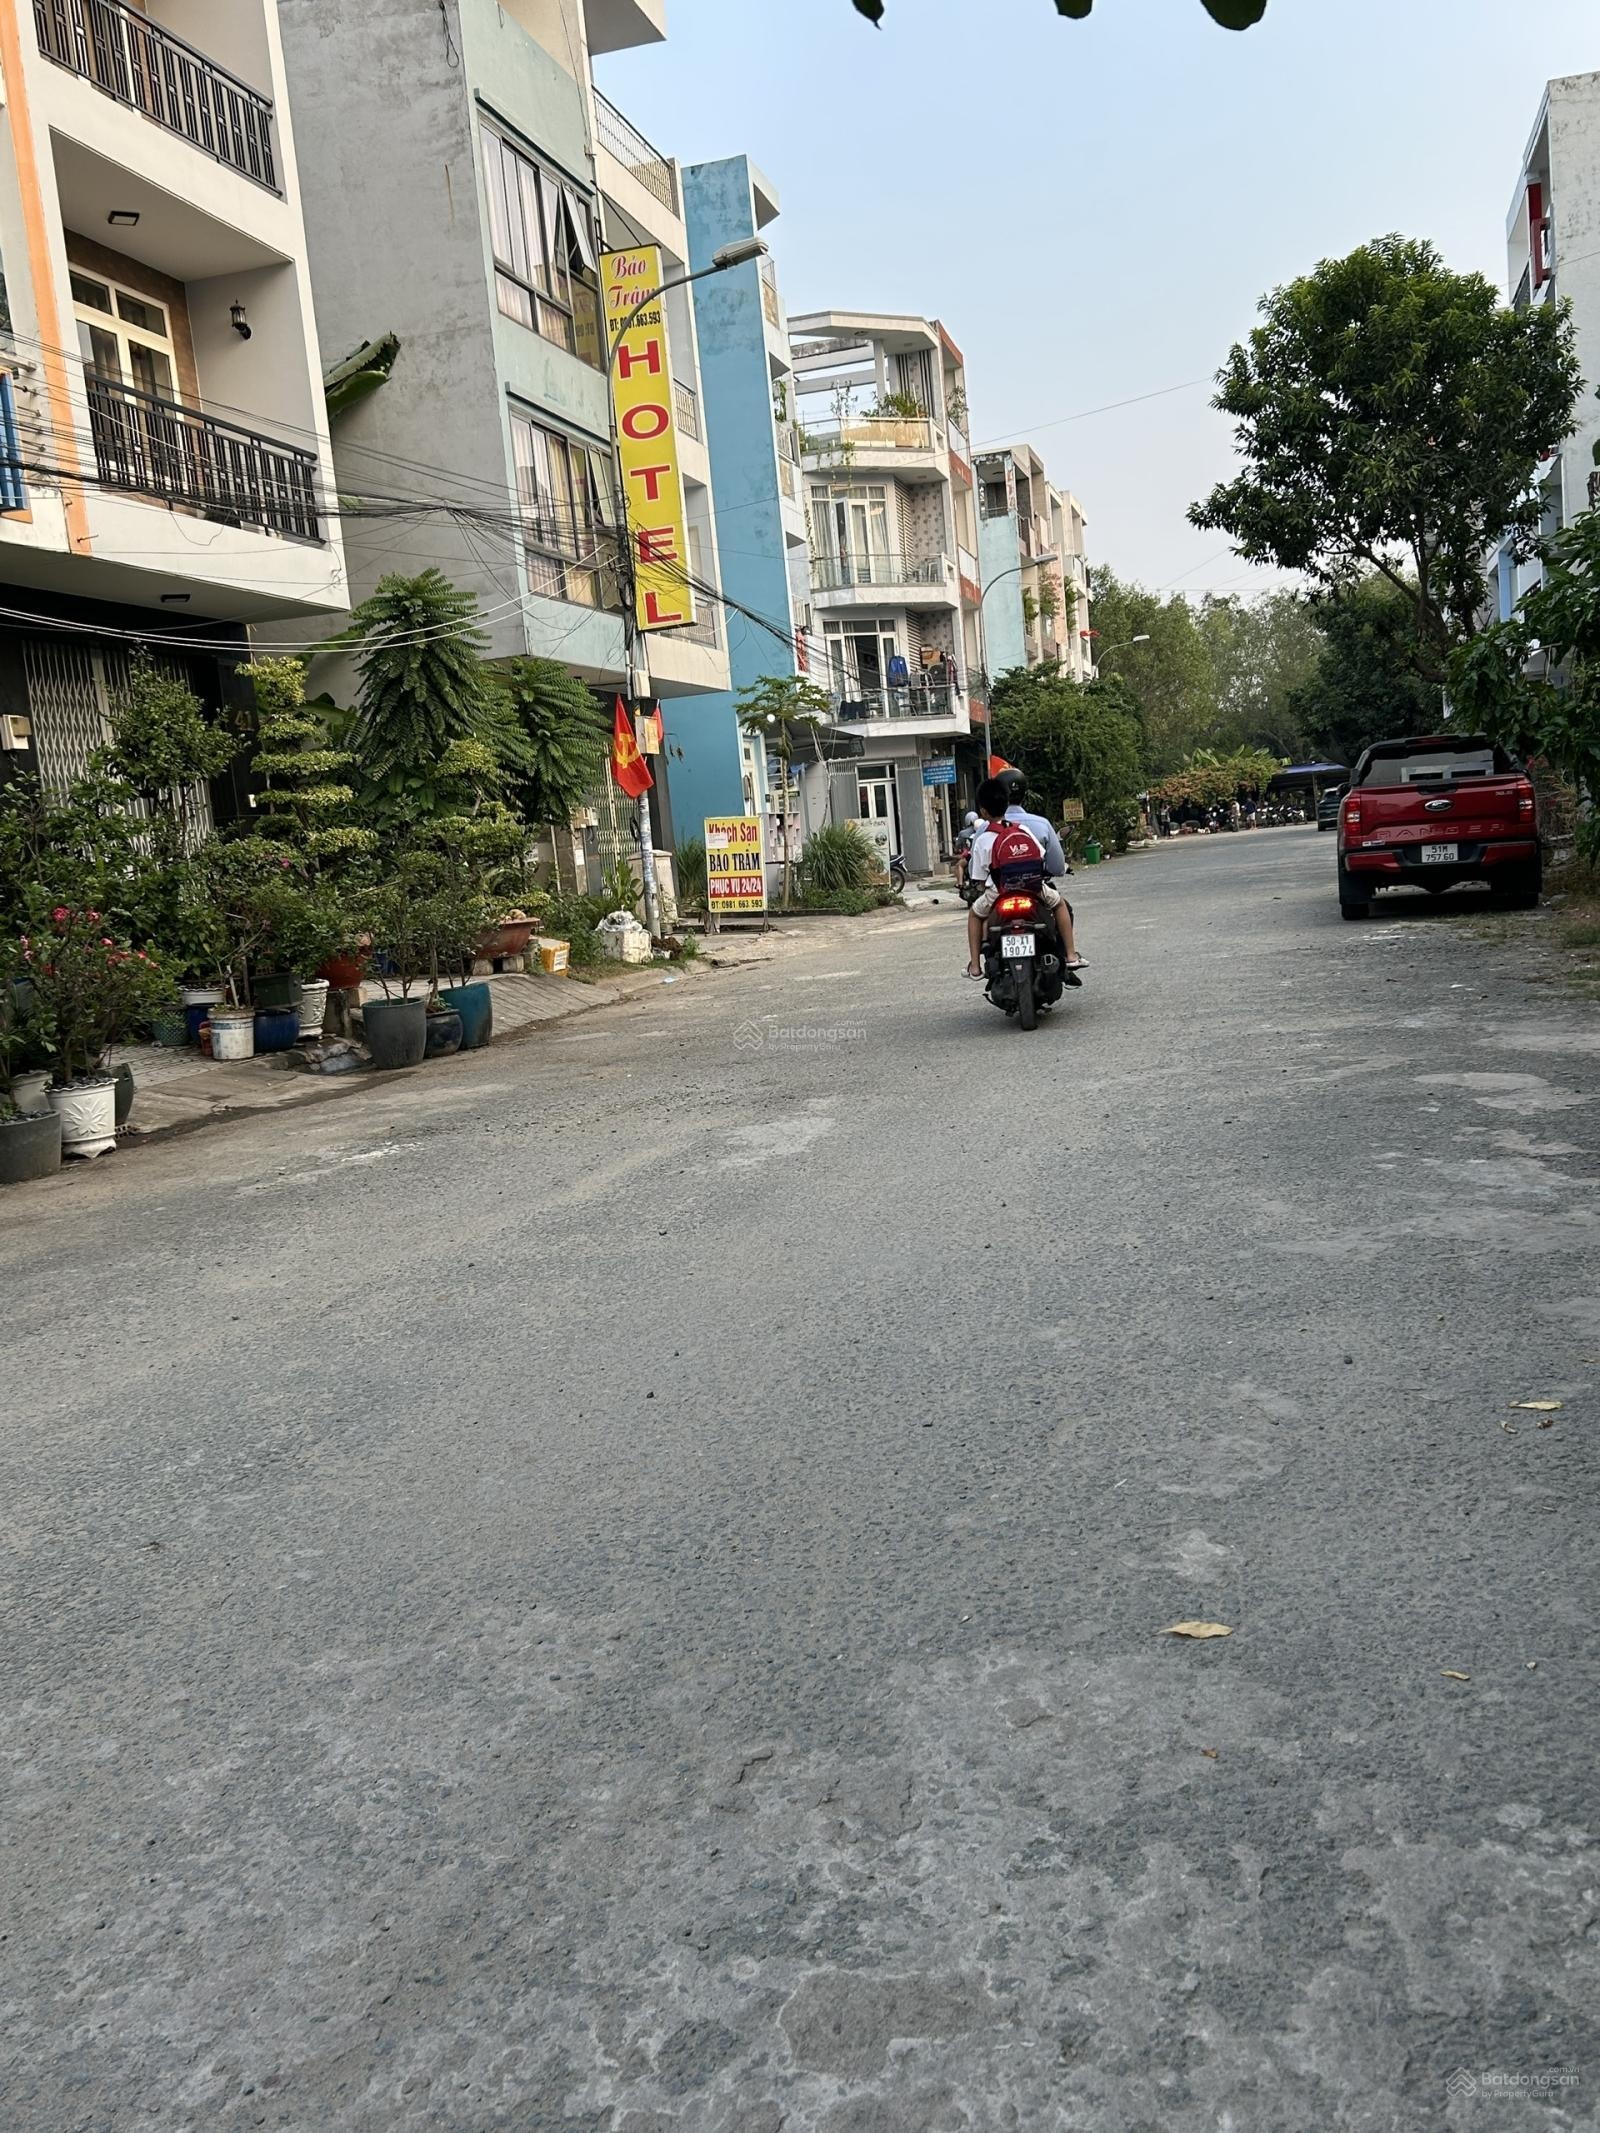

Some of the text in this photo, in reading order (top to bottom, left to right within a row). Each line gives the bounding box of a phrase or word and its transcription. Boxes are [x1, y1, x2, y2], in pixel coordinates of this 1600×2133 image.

[611, 255, 646, 279] Bảo
[618, 338, 682, 625] HOTEL
[1375, 823, 1504, 840] RANGER
[709, 849, 729, 872] BẢO
[710, 878, 730, 897] PHỤC
[741, 877, 761, 894] 24/24
